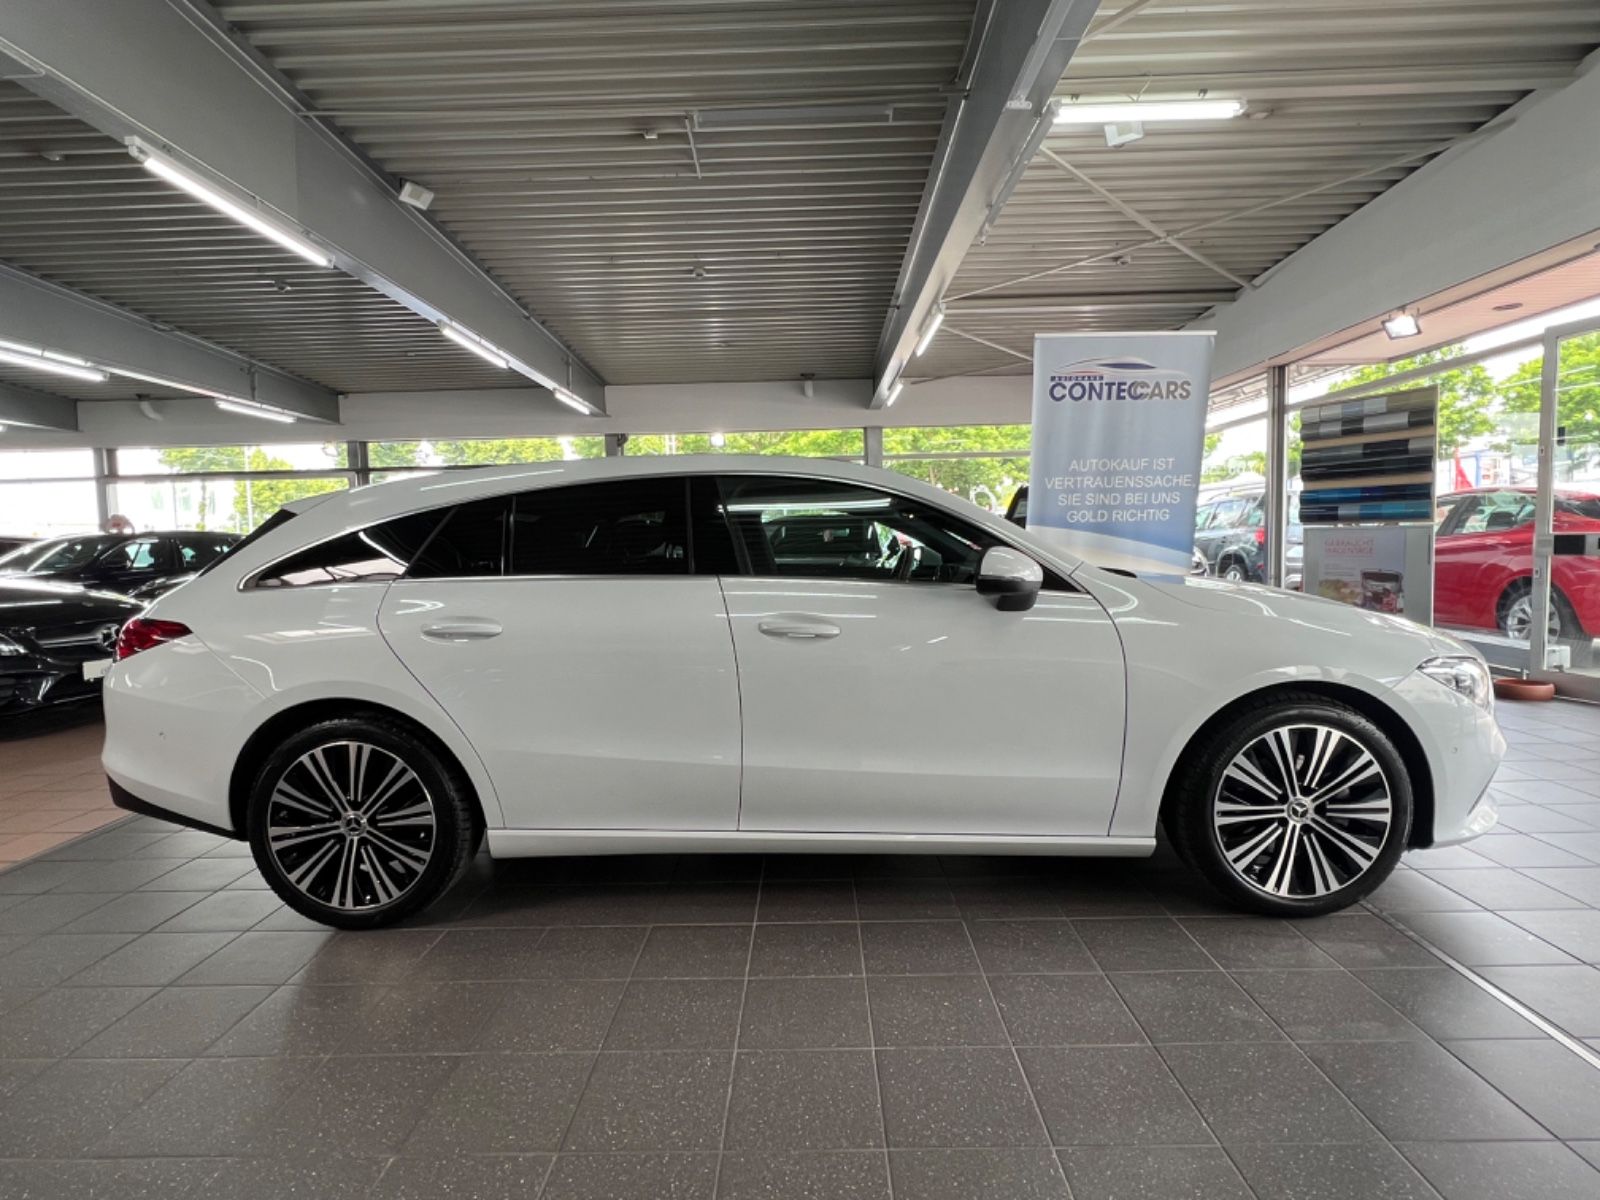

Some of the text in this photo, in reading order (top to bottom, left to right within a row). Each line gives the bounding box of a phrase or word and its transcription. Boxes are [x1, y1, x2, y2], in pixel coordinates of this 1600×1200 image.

[1069, 458, 1175, 472] AUTOKAUF IST
[1058, 492, 1181, 506] SIE SIND BEI UNS
[1066, 509, 1169, 523] GOLD RICHTIG
